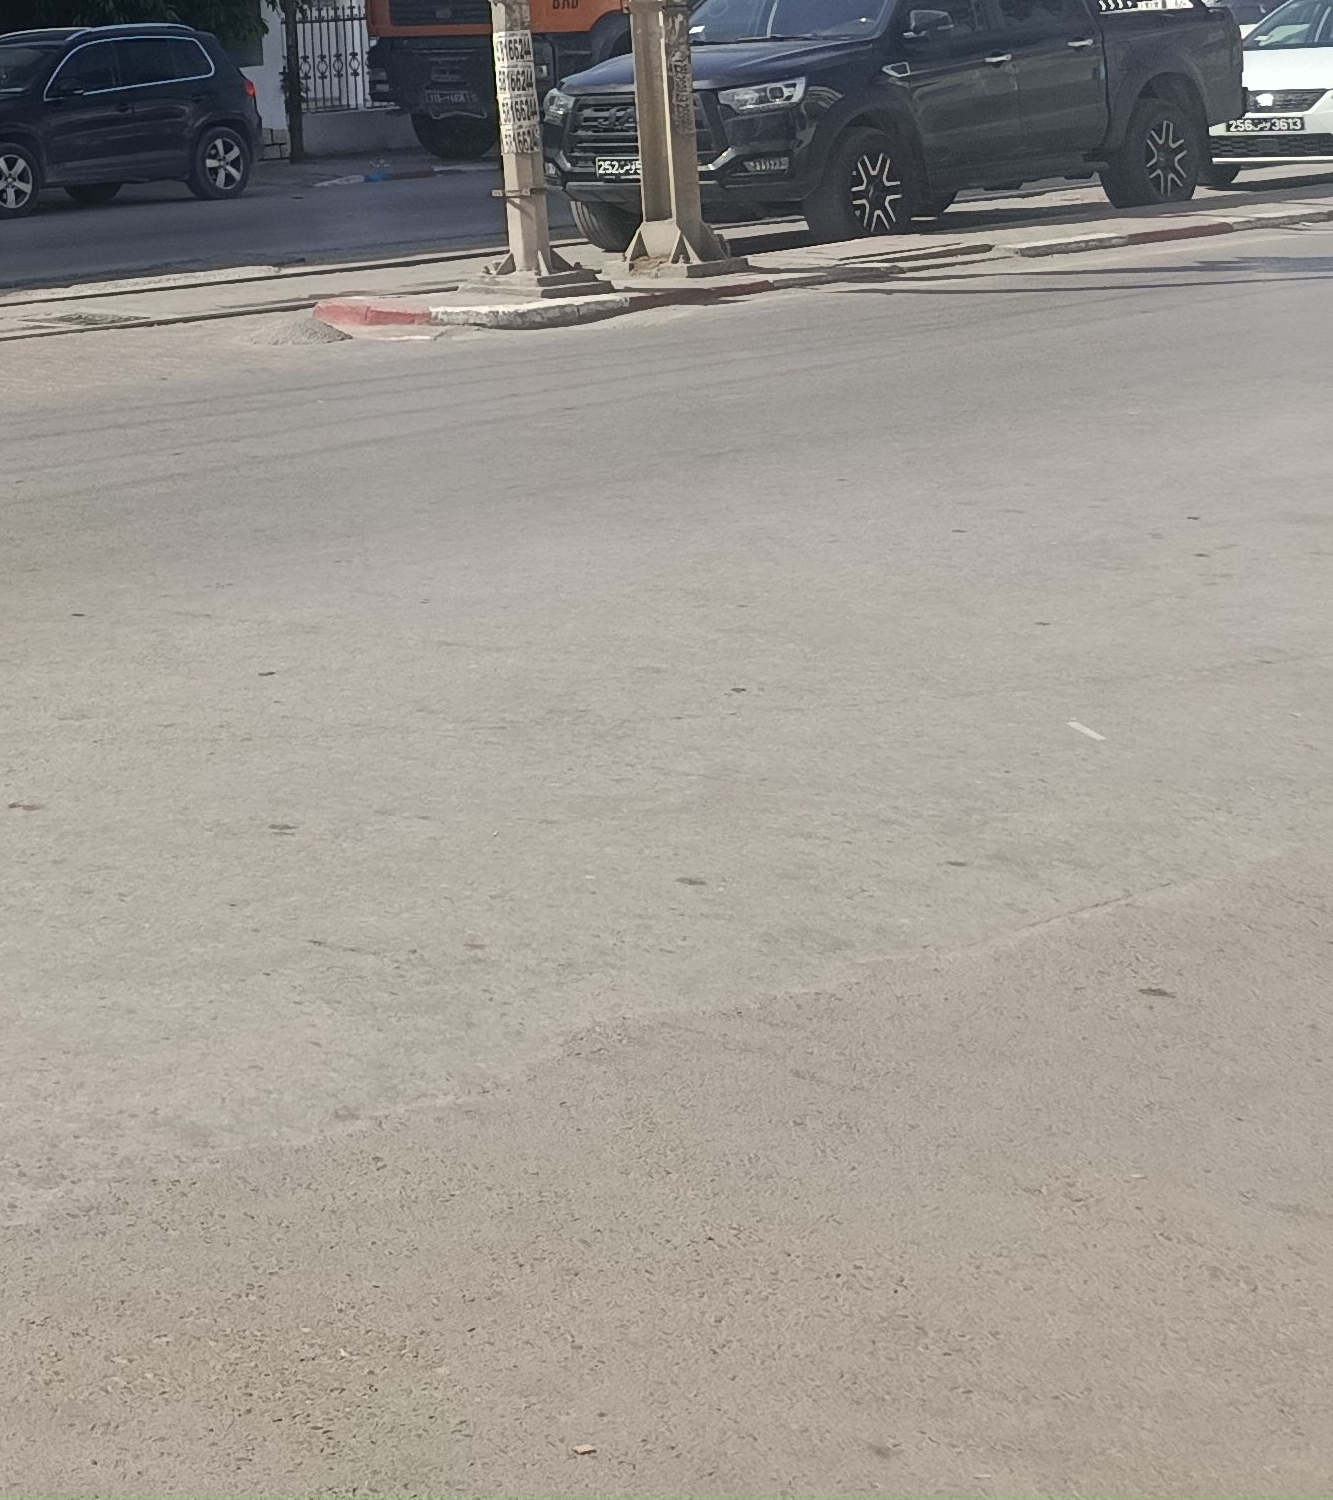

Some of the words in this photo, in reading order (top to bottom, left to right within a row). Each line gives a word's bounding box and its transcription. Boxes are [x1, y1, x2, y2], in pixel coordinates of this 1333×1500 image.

[1228, 119, 1253, 132] 256
[1271, 118, 1302, 131] 3613
[598, 160, 619, 174] 252
